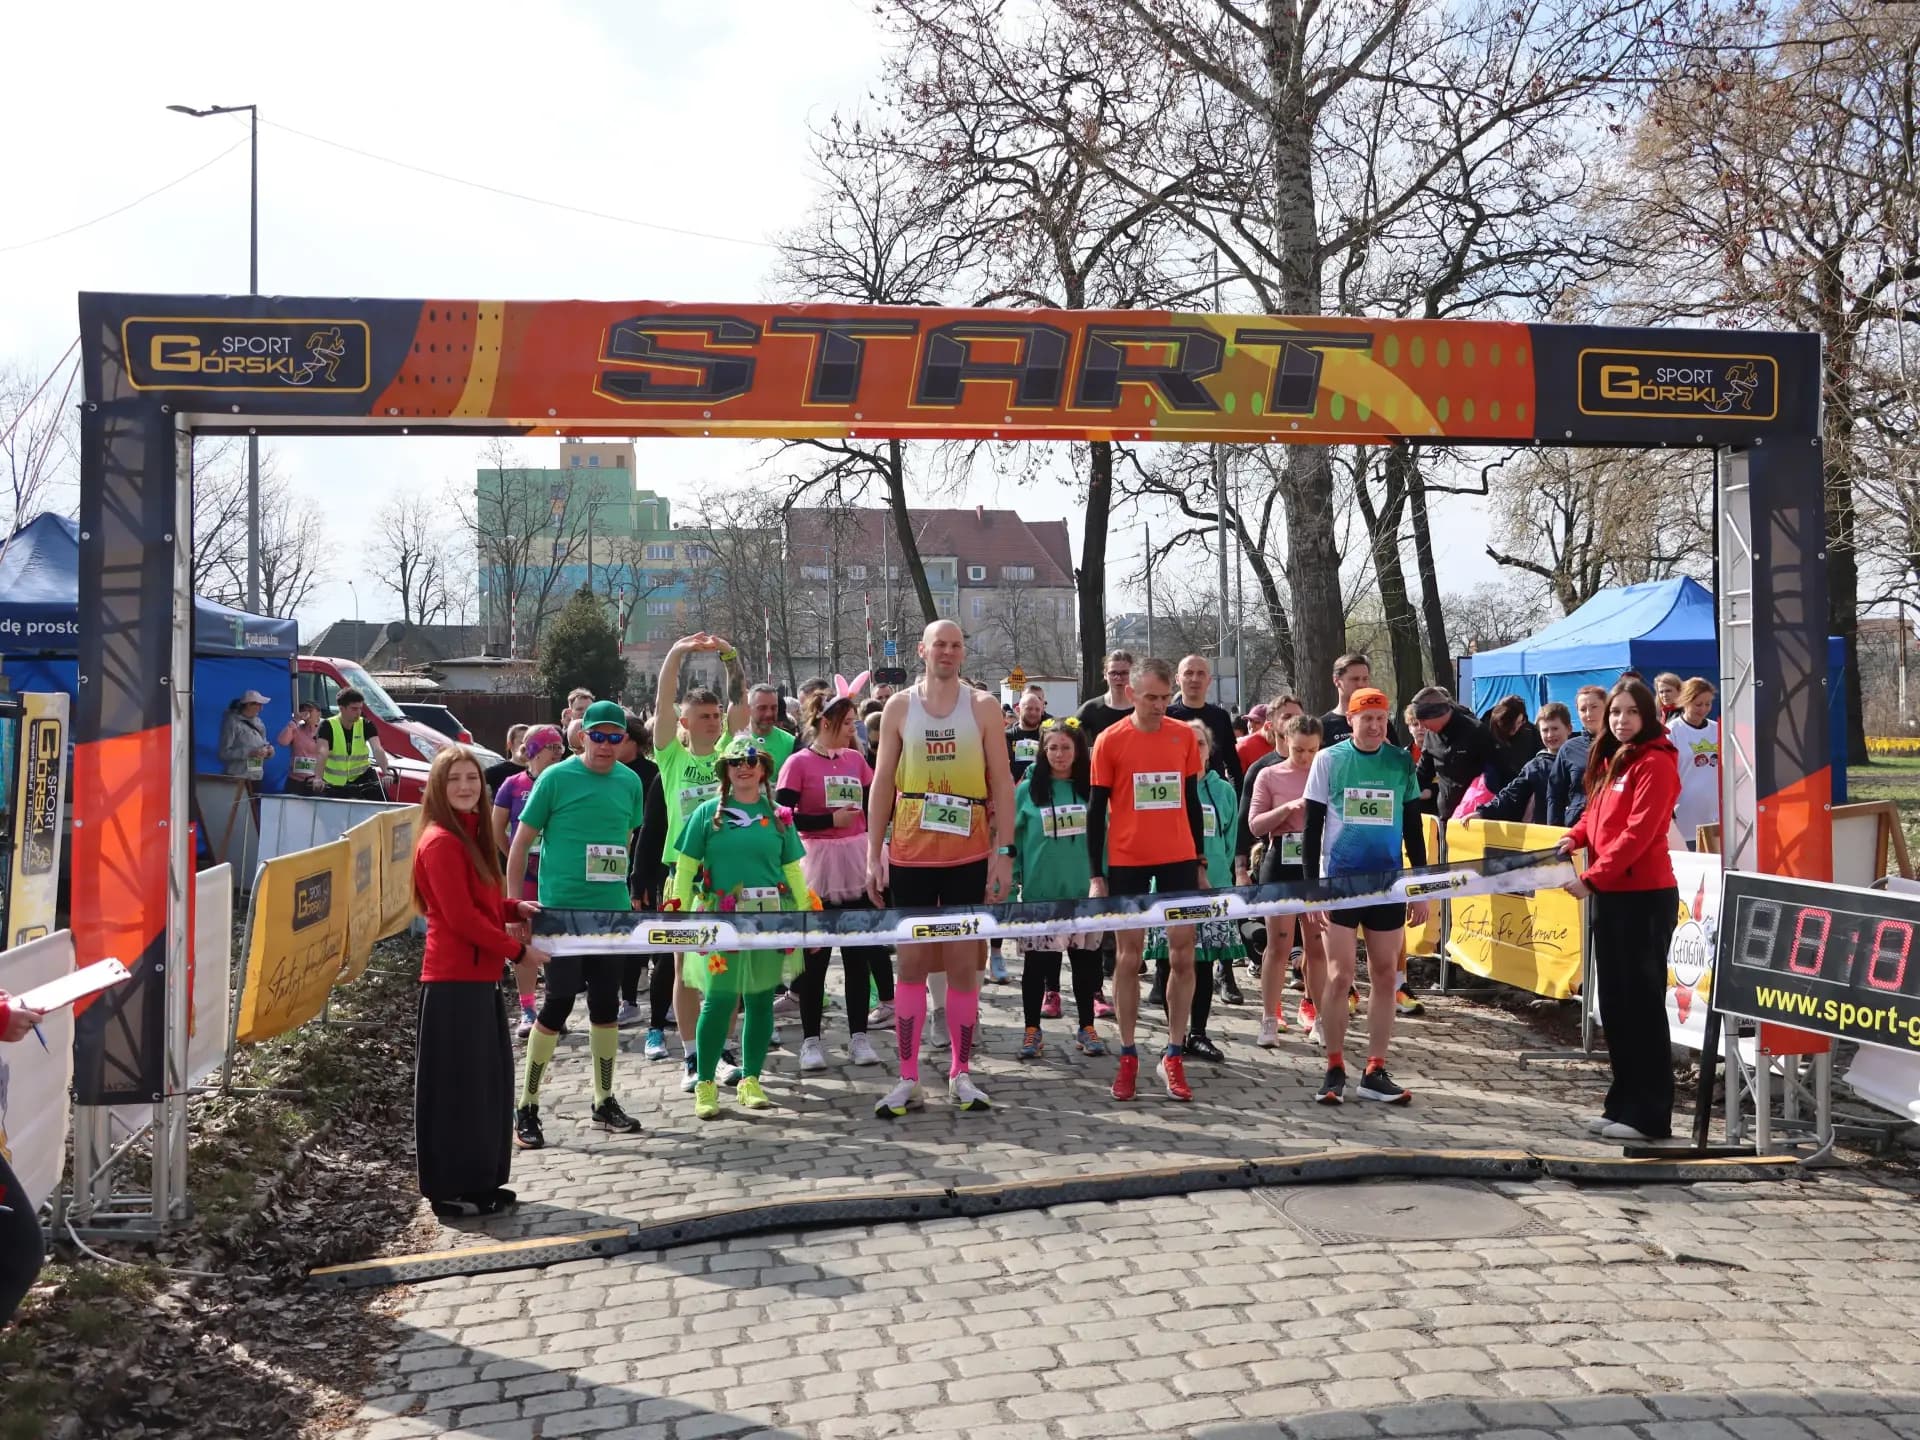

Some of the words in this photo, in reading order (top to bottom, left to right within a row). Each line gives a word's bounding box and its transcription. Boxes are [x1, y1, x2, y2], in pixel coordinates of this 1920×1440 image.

[221, 336, 292, 354] SPORT
[150, 335, 294, 375] GÓRSKI
[594, 314, 1373, 416] START
[1600, 365, 1716, 402] GÓRSKI
[1656, 367, 1714, 385] SPORT
[1024, 748, 1035, 757] 13
[33, 719, 60, 835] GÓRSKI
[839, 787, 854, 800] 44
[1150, 786, 1167, 800] 19
[45, 774, 58, 832] SPORT
[1359, 801, 1378, 816] 66
[937, 808, 958, 824] 26
[1057, 815, 1074, 828] 11
[600, 858, 617, 873] 70
[672, 929, 697, 937] SPORT
[1672, 935, 1706, 969] GŁOGÓW
[1755, 985, 1920, 1047] www.sport-g
